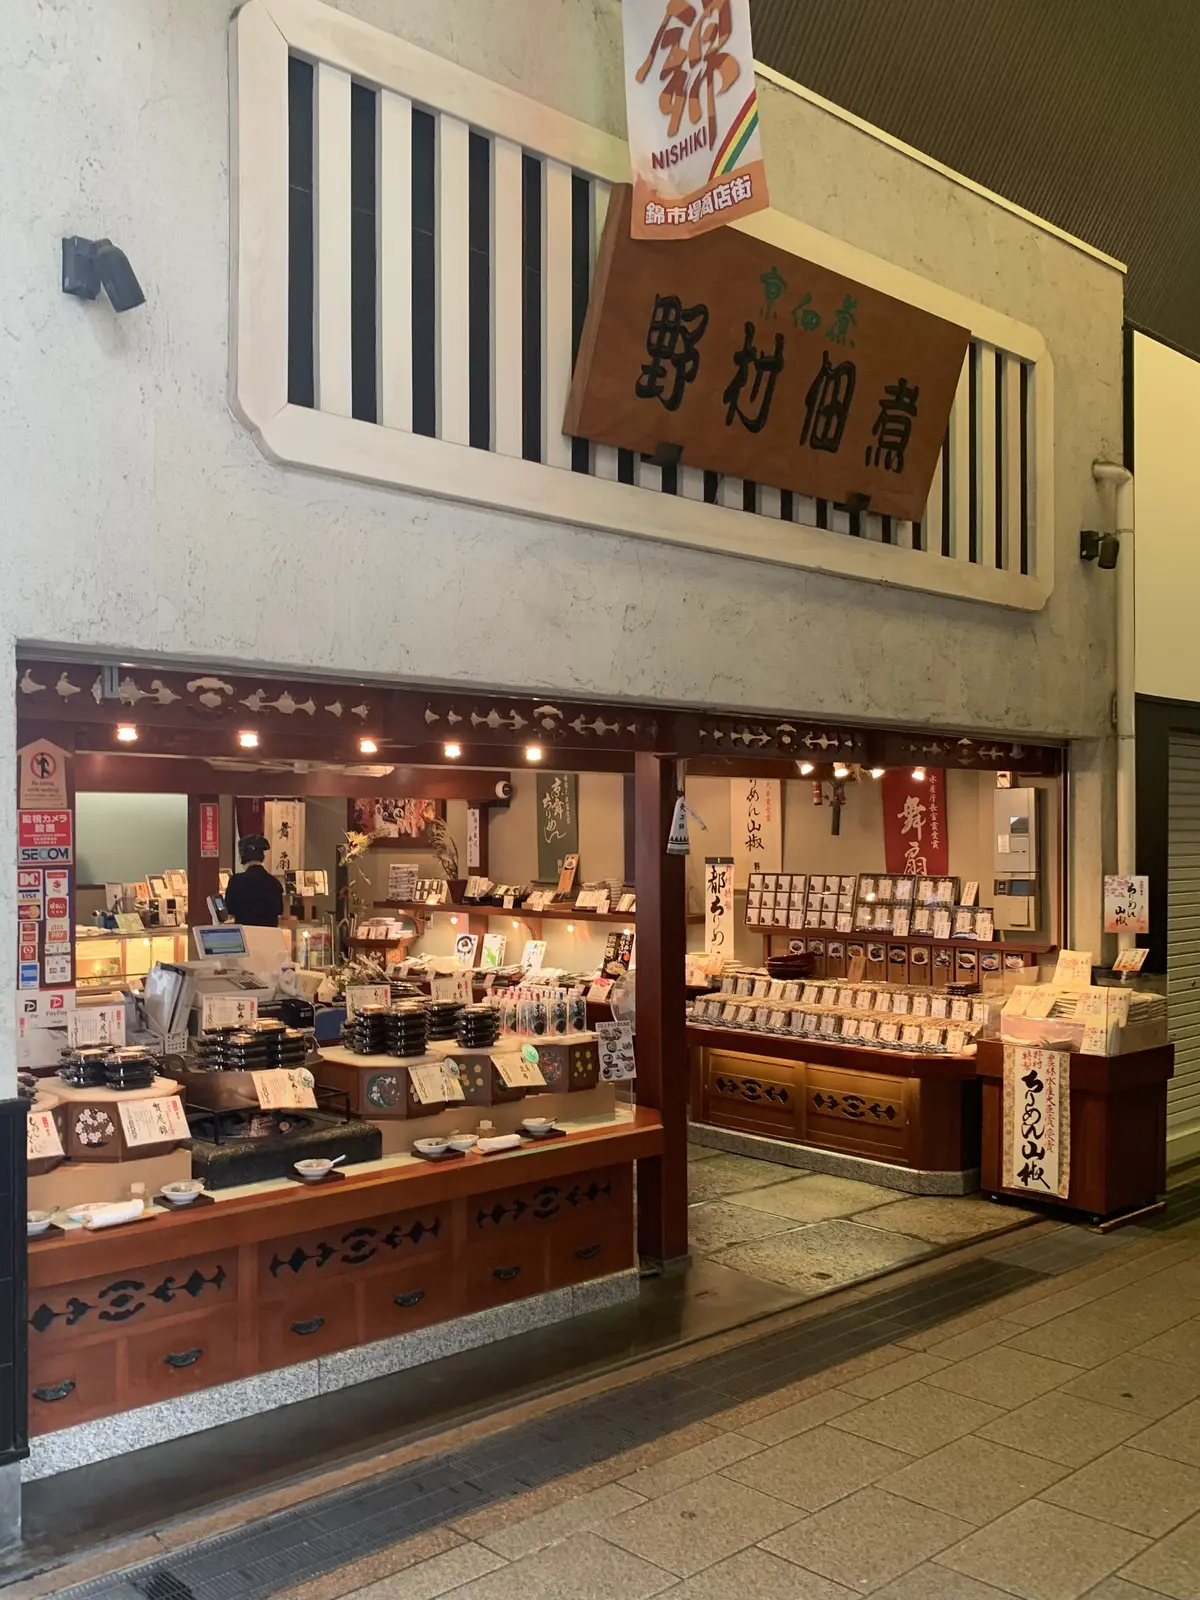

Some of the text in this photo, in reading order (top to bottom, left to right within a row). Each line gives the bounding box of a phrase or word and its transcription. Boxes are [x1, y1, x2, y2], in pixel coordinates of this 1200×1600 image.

[651, 126, 707, 169] NISHIKI
[645, 173, 753, 225] 錦市場商店街
[634, 293, 920, 474] 野村佃煮
[22, 814, 67, 823] 監視カメラ
[22, 848, 68, 860] SECOM
[20, 873, 39, 886] DC
